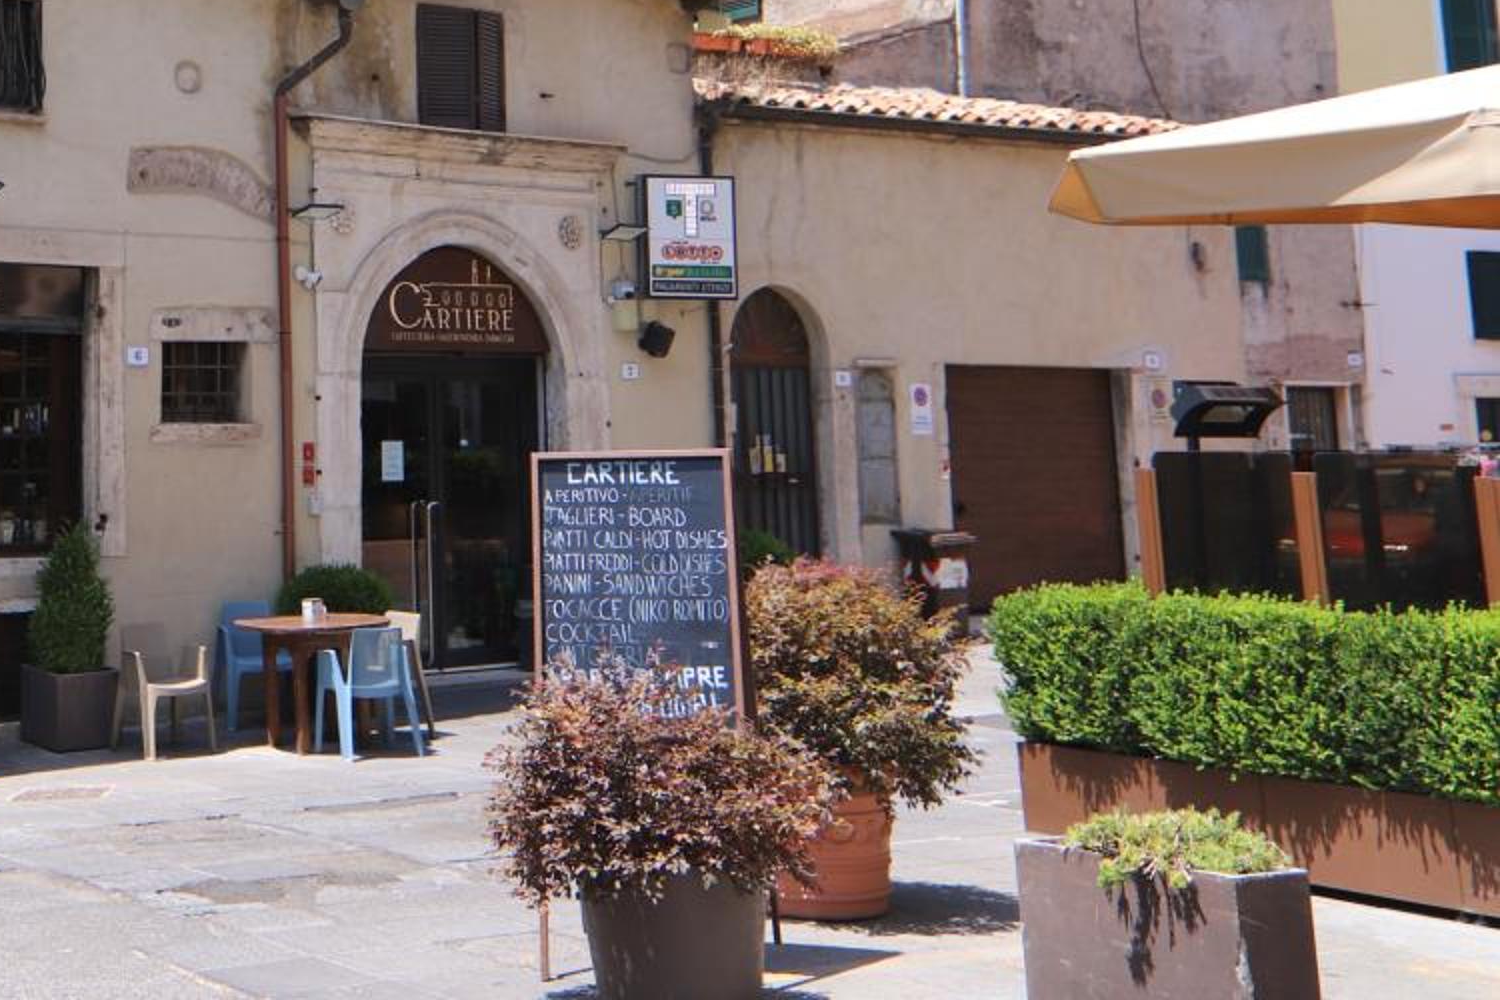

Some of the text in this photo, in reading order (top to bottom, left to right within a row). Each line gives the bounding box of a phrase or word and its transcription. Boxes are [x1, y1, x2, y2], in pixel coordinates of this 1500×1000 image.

[389, 281, 514, 331] CARTIERE
[567, 461, 680, 485] CARTIERE
[628, 505, 687, 527] BOARD
[675, 529, 728, 549] DISHES
[679, 552, 727, 575] DISHES
[544, 573, 592, 593] PANINI
[545, 623, 638, 644] COCKTAIL
